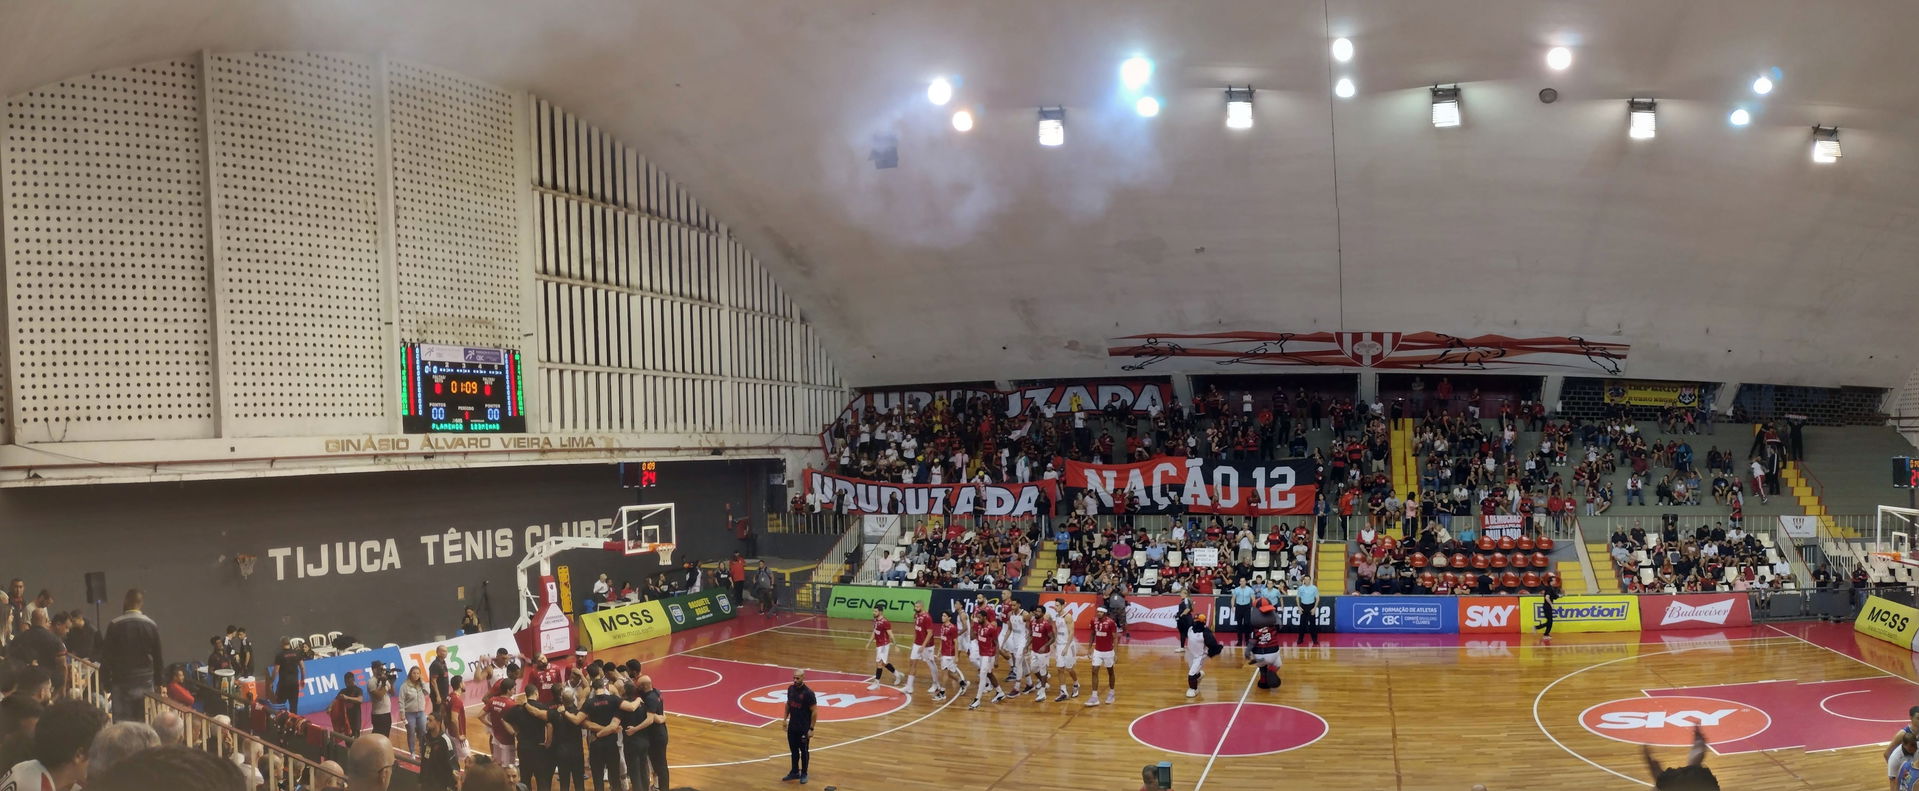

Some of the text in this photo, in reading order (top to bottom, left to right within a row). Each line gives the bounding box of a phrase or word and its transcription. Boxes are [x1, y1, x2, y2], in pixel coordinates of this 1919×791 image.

[431, 407, 445, 420] 00
[872, 382, 1167, 422] URUZADA
[487, 408, 500, 421] 00
[499, 436, 553, 450] VIEIRA
[559, 435, 596, 449] LIMA
[1083, 457, 1297, 511] NAÇÃO 12
[267, 538, 402, 581] TIJUCA
[420, 526, 513, 566] TÊNIS
[1382, 615, 1400, 625] CBC
[1464, 604, 1516, 628] SKY
[1665, 605, 1729, 619] Budweiser
[303, 673, 339, 696] TIM
[1595, 707, 1738, 730] SKY
